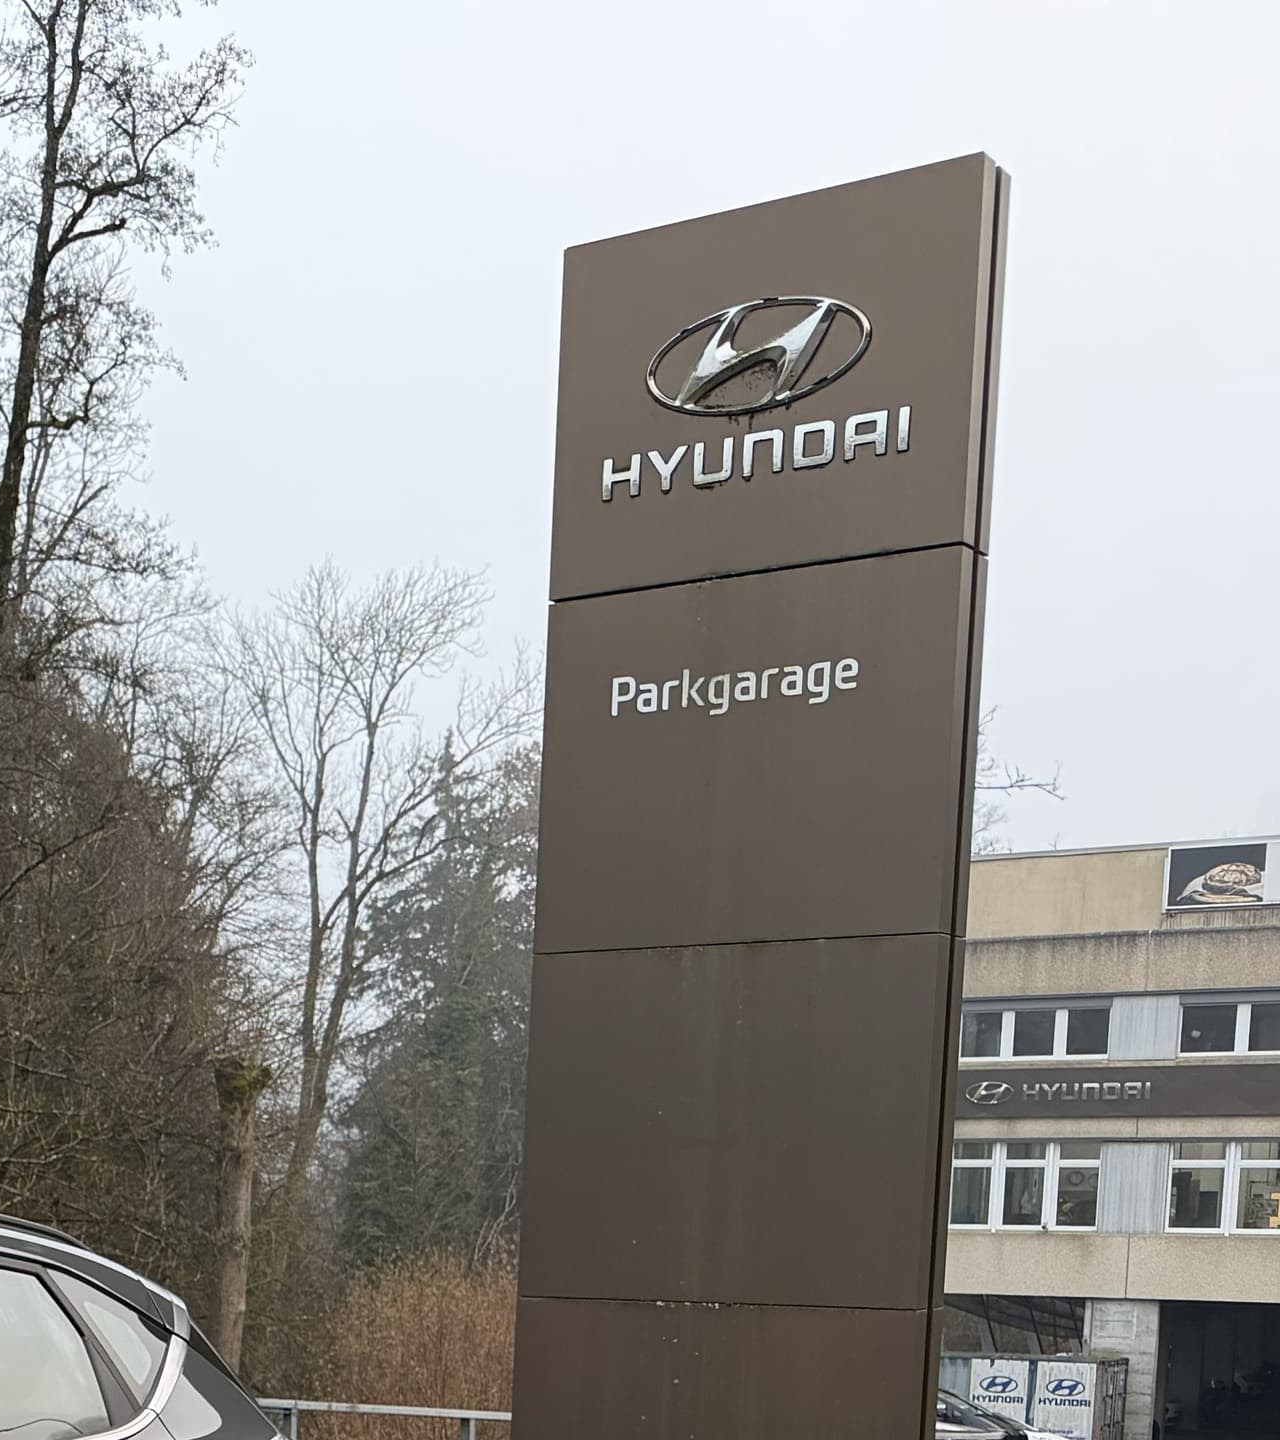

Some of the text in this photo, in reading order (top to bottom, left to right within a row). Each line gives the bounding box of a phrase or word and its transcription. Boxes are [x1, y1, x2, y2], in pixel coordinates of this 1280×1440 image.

[601, 405, 912, 502] HYUNDAI
[610, 657, 860, 717] Parkgarage
[1022, 1081, 1152, 1101] HYUNDAI
[972, 1394, 1024, 1404] HYUNDAI
[1038, 1397, 1091, 1408] HYUNDAI
